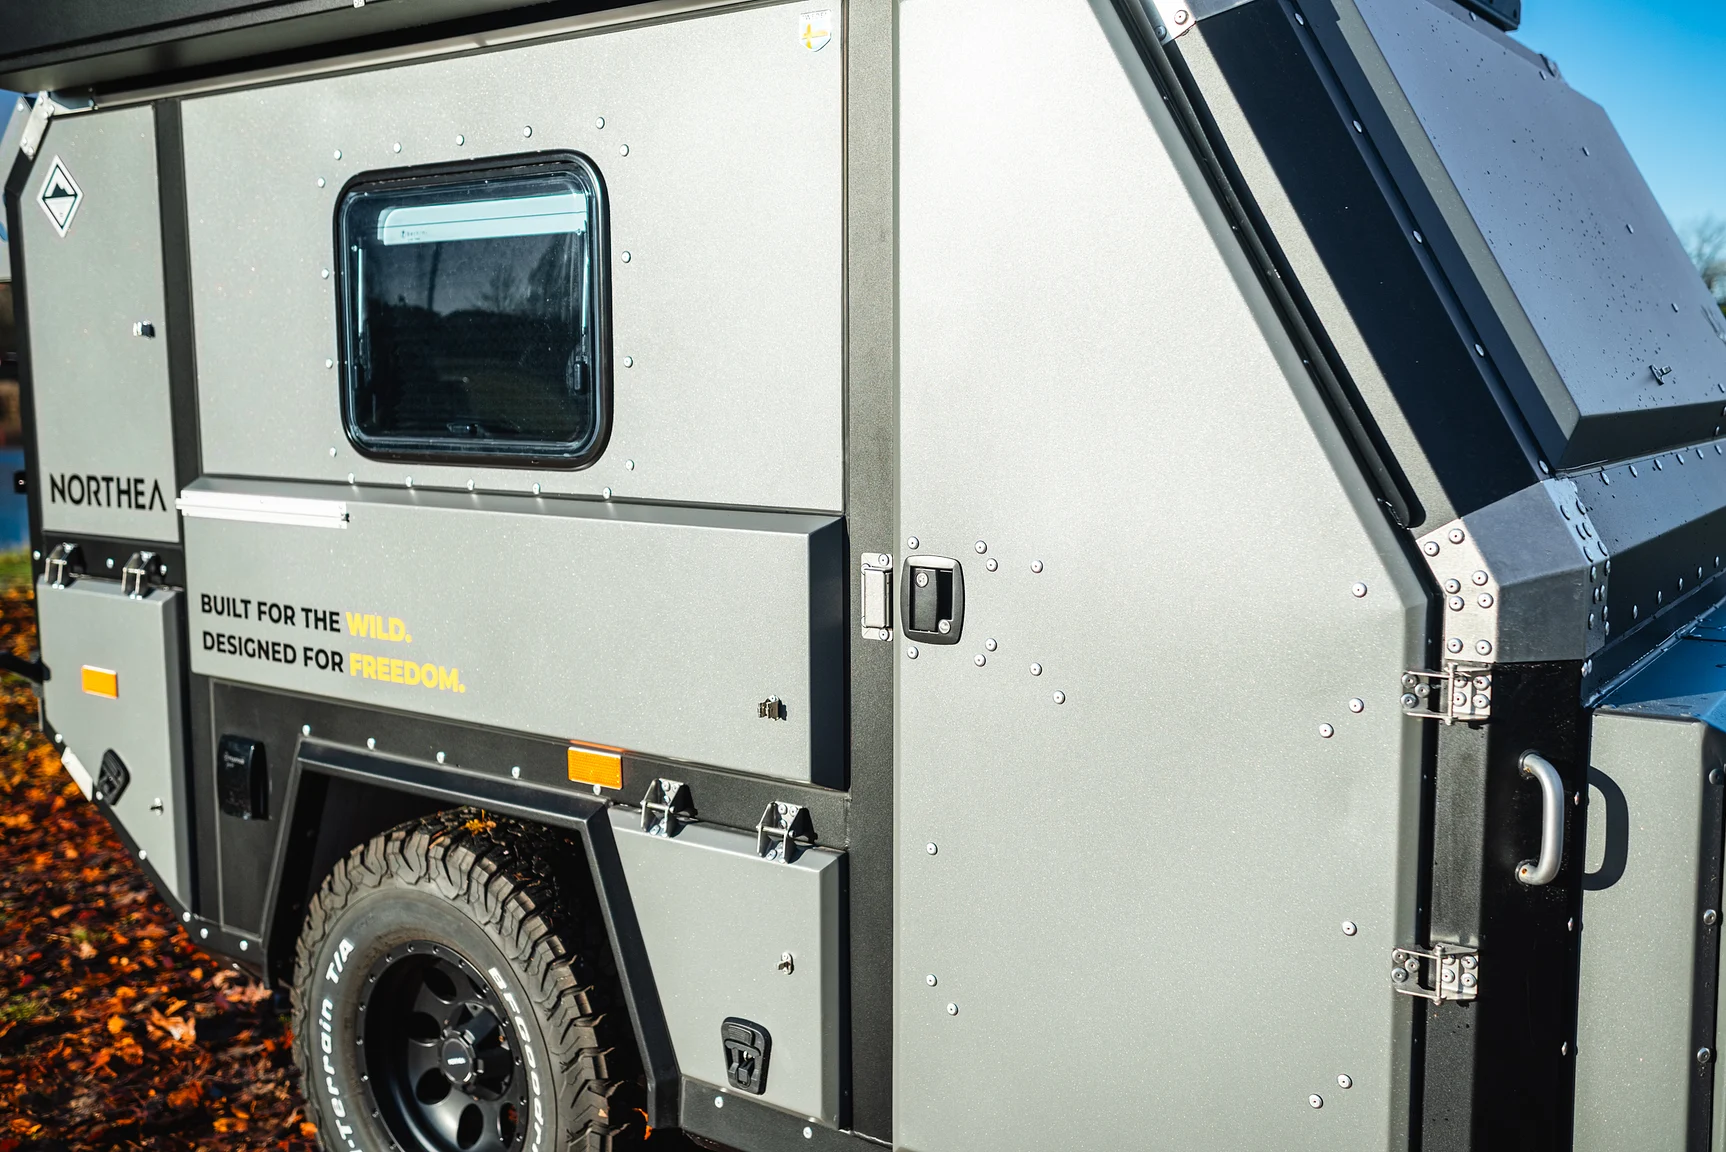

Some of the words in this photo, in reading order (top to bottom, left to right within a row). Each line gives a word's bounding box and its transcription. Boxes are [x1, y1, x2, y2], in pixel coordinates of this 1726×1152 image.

[49, 473, 167, 512] NORTHEA
[201, 593, 251, 619] BUILT
[257, 601, 296, 627] FOR
[301, 607, 341, 633] THE
[345, 611, 413, 644] WILD.
[203, 630, 297, 664] DESIGNED
[303, 646, 344, 673] FOR
[349, 652, 466, 693] FREEDOM.
[326, 937, 355, 984] T/A
